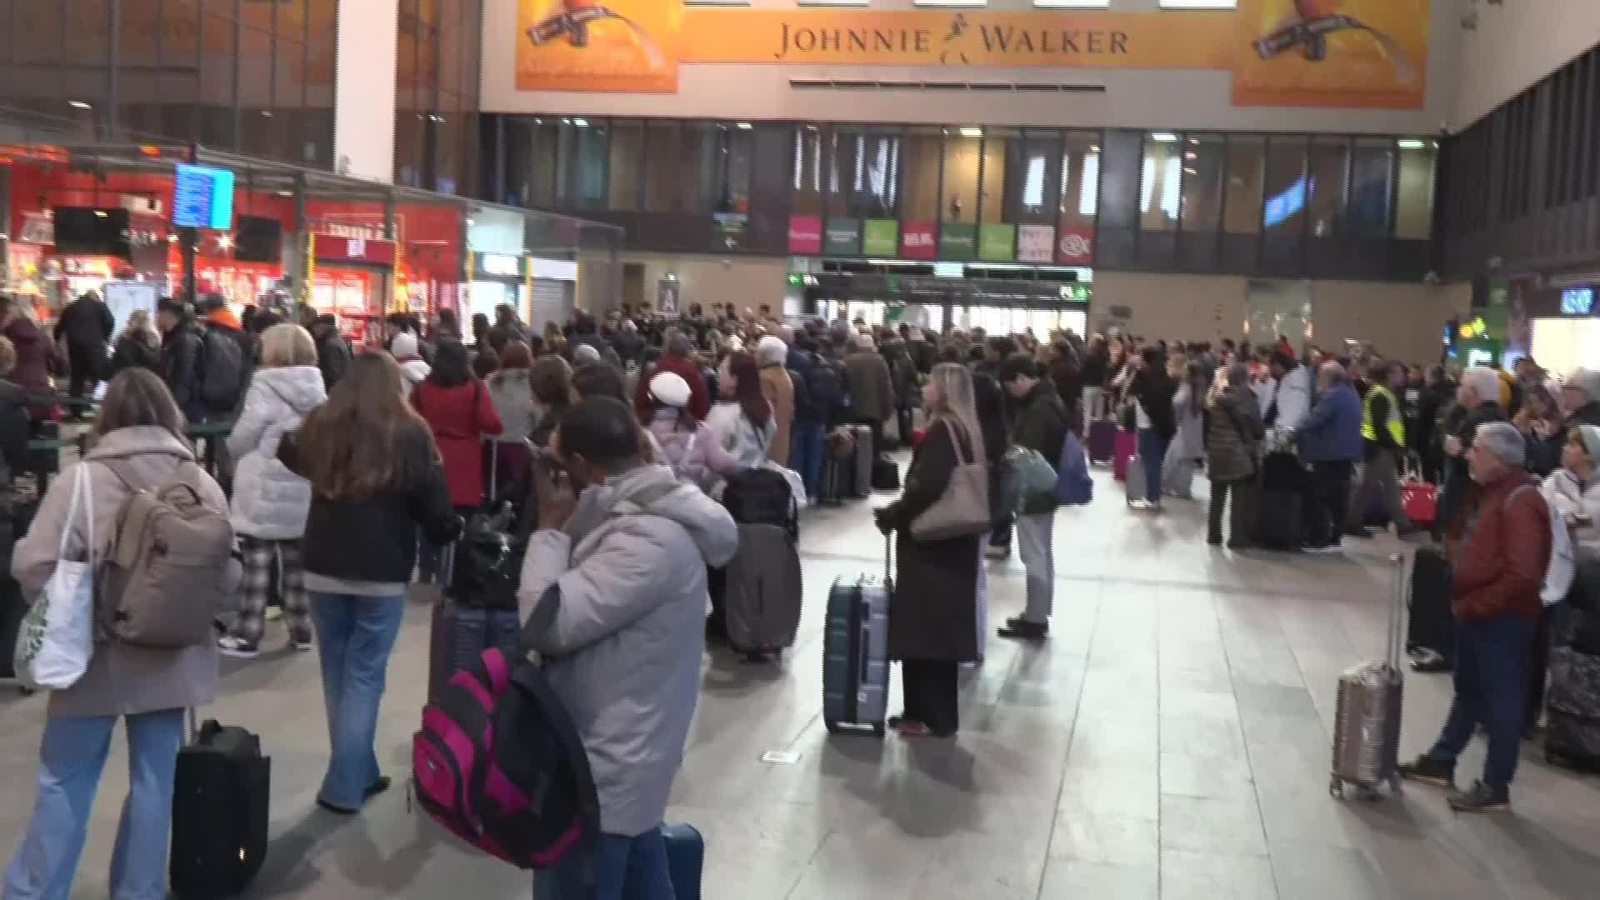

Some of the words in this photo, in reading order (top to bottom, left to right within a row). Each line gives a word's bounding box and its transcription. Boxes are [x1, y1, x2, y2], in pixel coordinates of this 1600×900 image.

[774, 22, 932, 60] JOHNNIE
[980, 24, 1130, 55] WALKER
[663, 289, 675, 311] A
